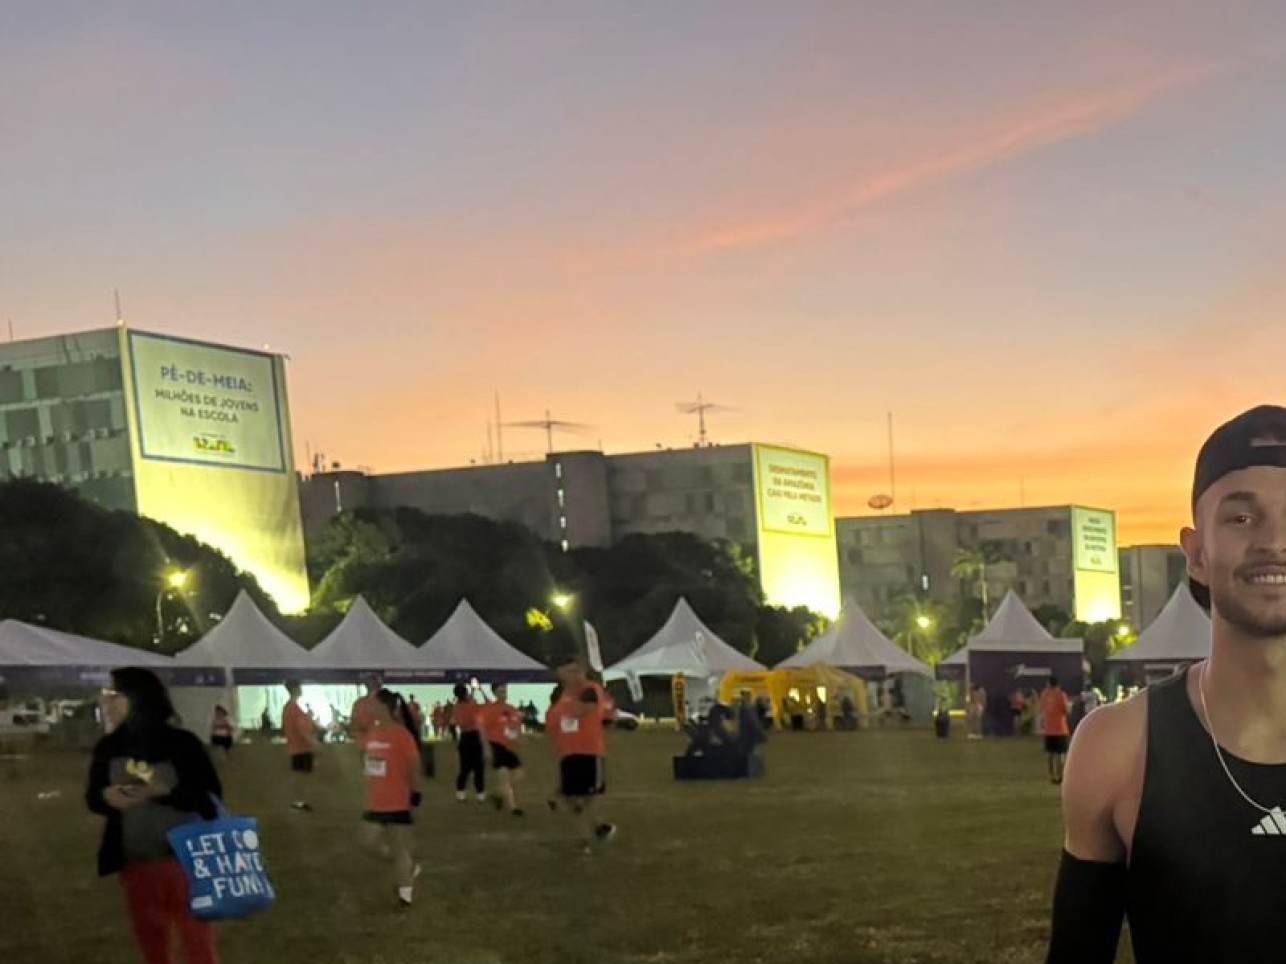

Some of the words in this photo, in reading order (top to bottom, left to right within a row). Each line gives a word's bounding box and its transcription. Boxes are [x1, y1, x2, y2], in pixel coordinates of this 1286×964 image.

[160, 364, 254, 392] PÉ-DE-MEIA:
[154, 388, 201, 406] MILHÕES
[204, 395, 219, 407] DE
[220, 396, 260, 412] JOVENS
[180, 407, 195, 418] NA
[197, 408, 240, 424] ESCOLA
[186, 832, 226, 857] LET
